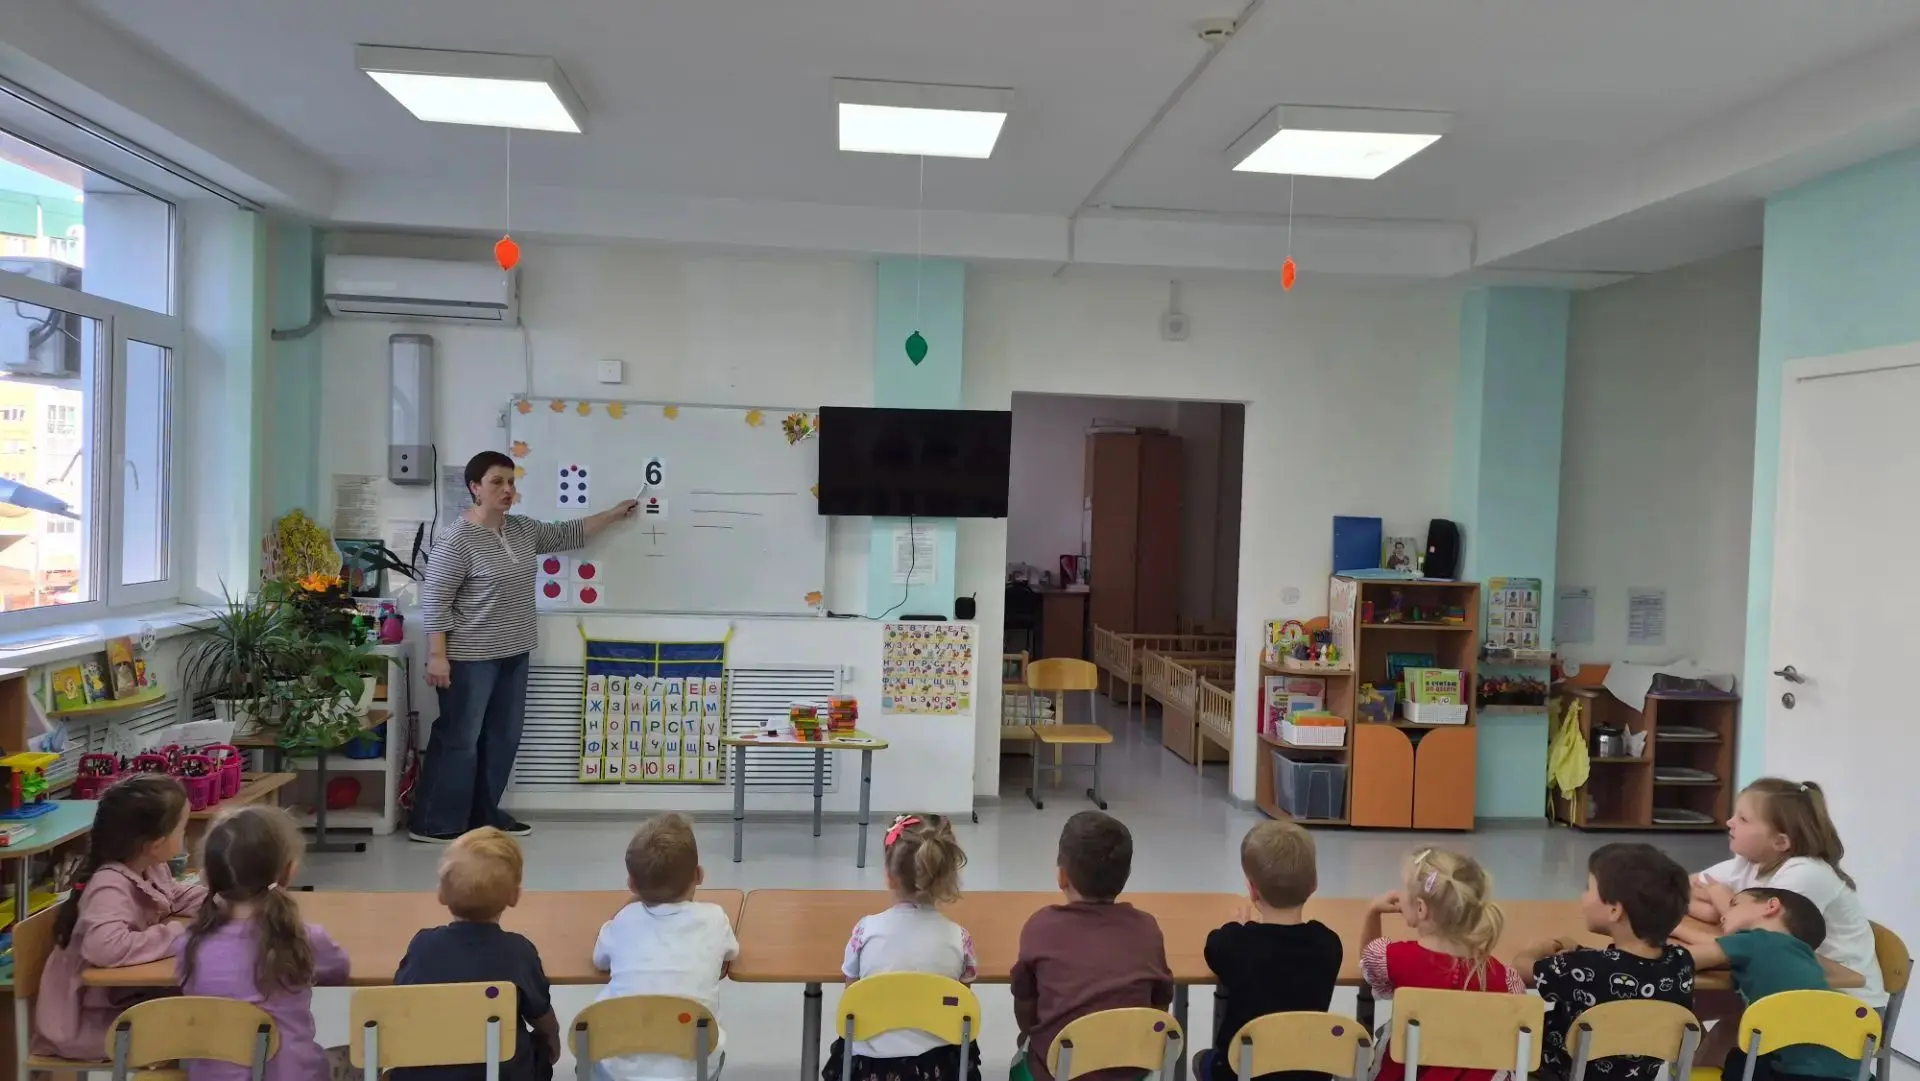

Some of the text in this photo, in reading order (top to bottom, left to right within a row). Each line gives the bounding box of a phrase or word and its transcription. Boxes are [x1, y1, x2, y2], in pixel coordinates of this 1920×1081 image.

[645, 462, 662, 485] 6
[591, 683, 599, 691] а
[611, 680, 620, 691] б
[690, 684, 698, 694] Е
[709, 682, 717, 693] ё
[708, 762, 711, 774] !
